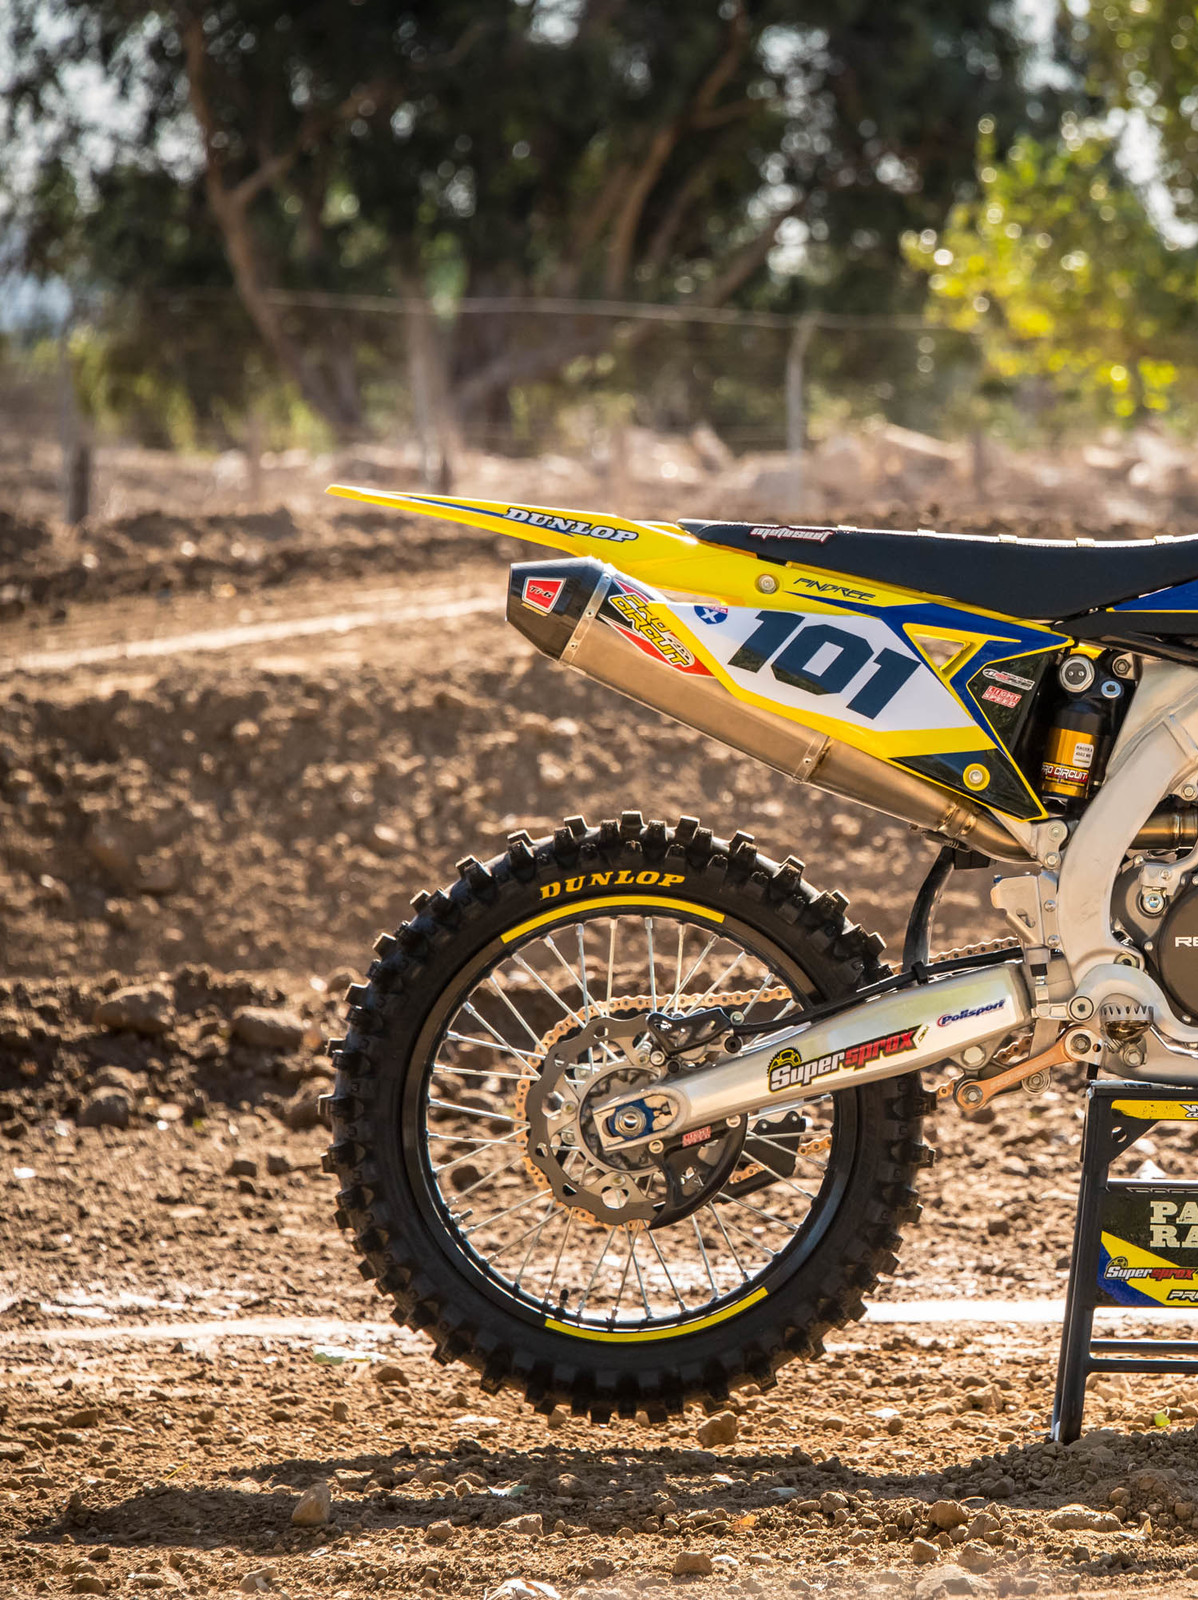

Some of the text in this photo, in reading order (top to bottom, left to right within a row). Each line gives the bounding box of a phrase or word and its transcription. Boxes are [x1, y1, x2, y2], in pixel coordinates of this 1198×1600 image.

[503, 508, 639, 542] DUNLOP
[793, 577, 876, 602] PINDREE
[626, 594, 671, 633] PRO
[610, 597, 689, 667] CIRCUIT
[727, 610, 922, 721] 101
[1054, 767, 1088, 781] CIRCUIT
[539, 869, 686, 900] DUNLOP
[940, 999, 1006, 1026] Polisport
